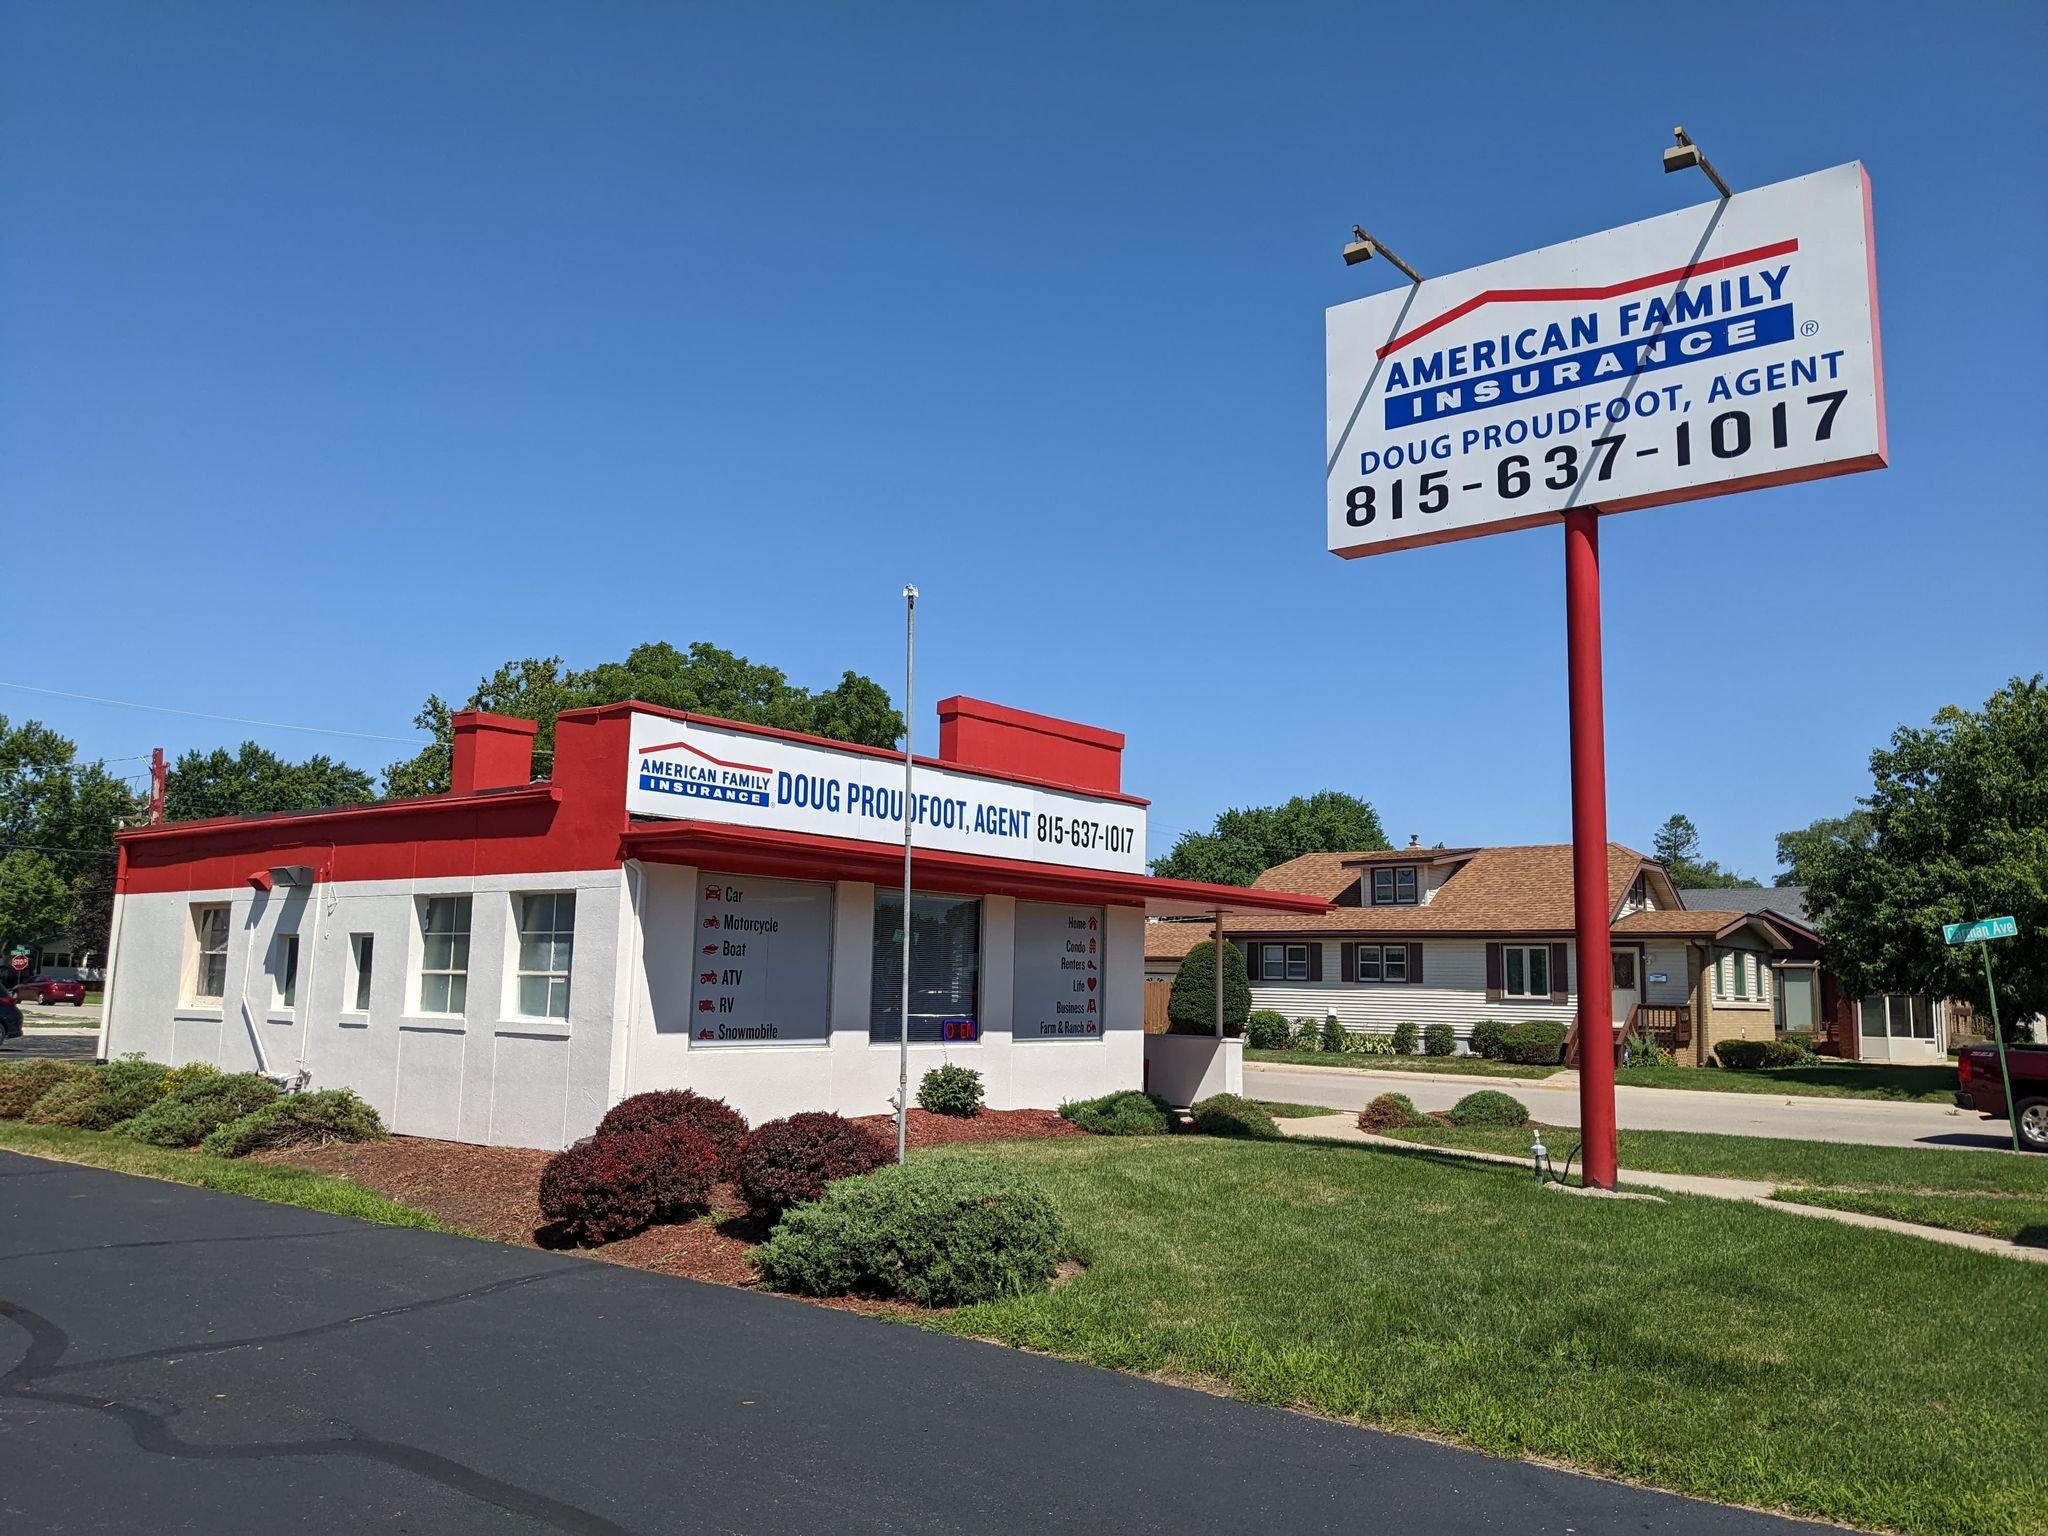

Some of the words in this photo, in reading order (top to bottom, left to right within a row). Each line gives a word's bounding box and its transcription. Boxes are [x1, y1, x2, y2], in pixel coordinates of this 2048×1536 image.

[1385, 313, 1598, 392] AMERICAN
[1620, 265, 1791, 336] FAMILY
[1413, 320, 1756, 417] INSURANCE
[1360, 434, 1451, 475] DOUG
[1463, 384, 1691, 454] PROUDFOOT,
[1708, 350, 1845, 404] AGENT
[1346, 389, 1848, 527] 815-637-1017
[640, 758, 717, 783] AMERICAN
[722, 771, 770, 791] FAMILY
[650, 778, 761, 804] INSURANCE
[777, 771, 840, 812] DOUG
[974, 803, 1031, 839] AGENT
[1037, 813, 1134, 854] 815-637-1017
[725, 886, 743, 903] Car
[724, 914, 779, 934] Motorcycle
[1068, 916, 1086, 930] Home
[1993, 921, 2014, 935] Ave
[722, 940, 746, 957] Boat
[1066, 940, 1086, 954] Condo
[1061, 957, 1085, 970] Renters
[721, 969, 742, 986] ATV
[1073, 979, 1085, 993] Life
[719, 997, 735, 1013] RV
[1056, 1001, 1085, 1014] Business
[718, 1023, 778, 1040] Snowmobile
[946, 1023, 973, 1039] OEN
[1040, 1021, 1057, 1034] Farm
[1057, 1021, 1064, 1034] &
[1065, 1020, 1084, 1034] Ranch
